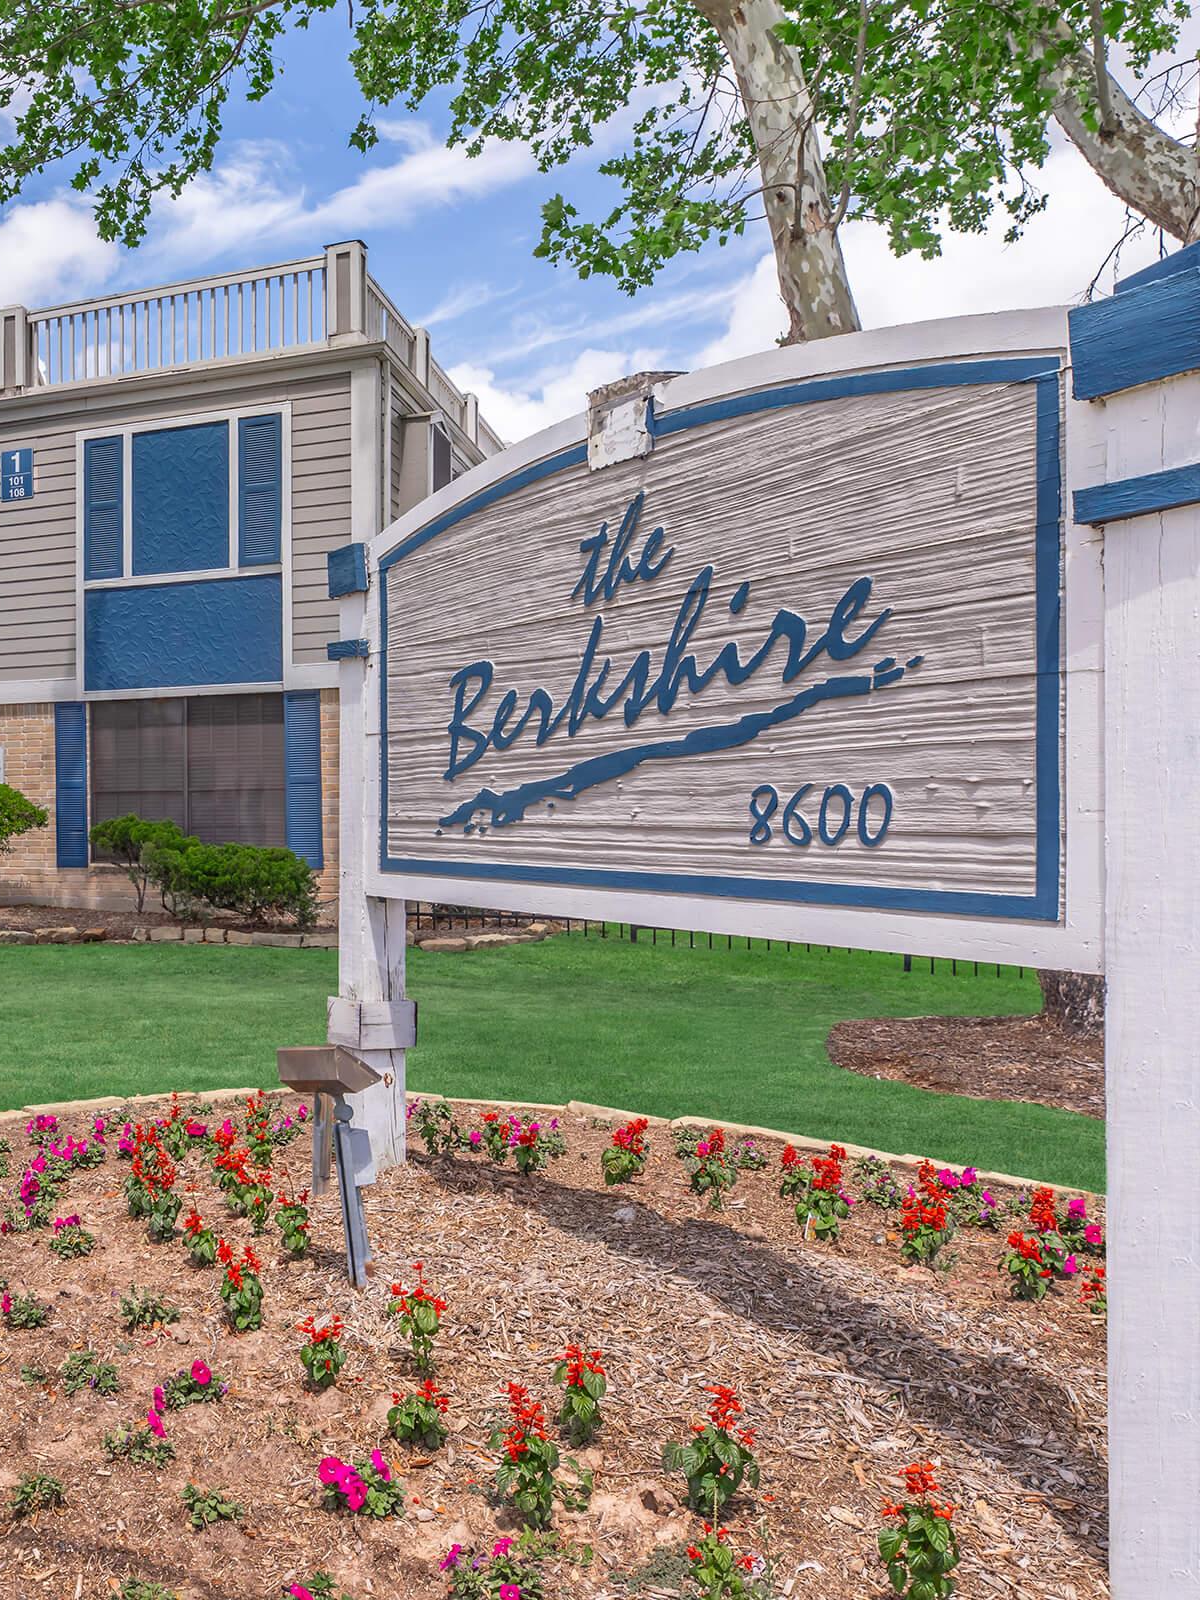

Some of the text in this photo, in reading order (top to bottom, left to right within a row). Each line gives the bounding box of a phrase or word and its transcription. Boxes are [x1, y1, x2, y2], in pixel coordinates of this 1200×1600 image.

[9, 476, 24, 486] 101
[11, 452, 20, 473] 1
[9, 488, 25, 498] 108
[571, 490, 673, 607] the
[442, 566, 892, 781] Berkshire
[749, 783, 892, 847] 8600
